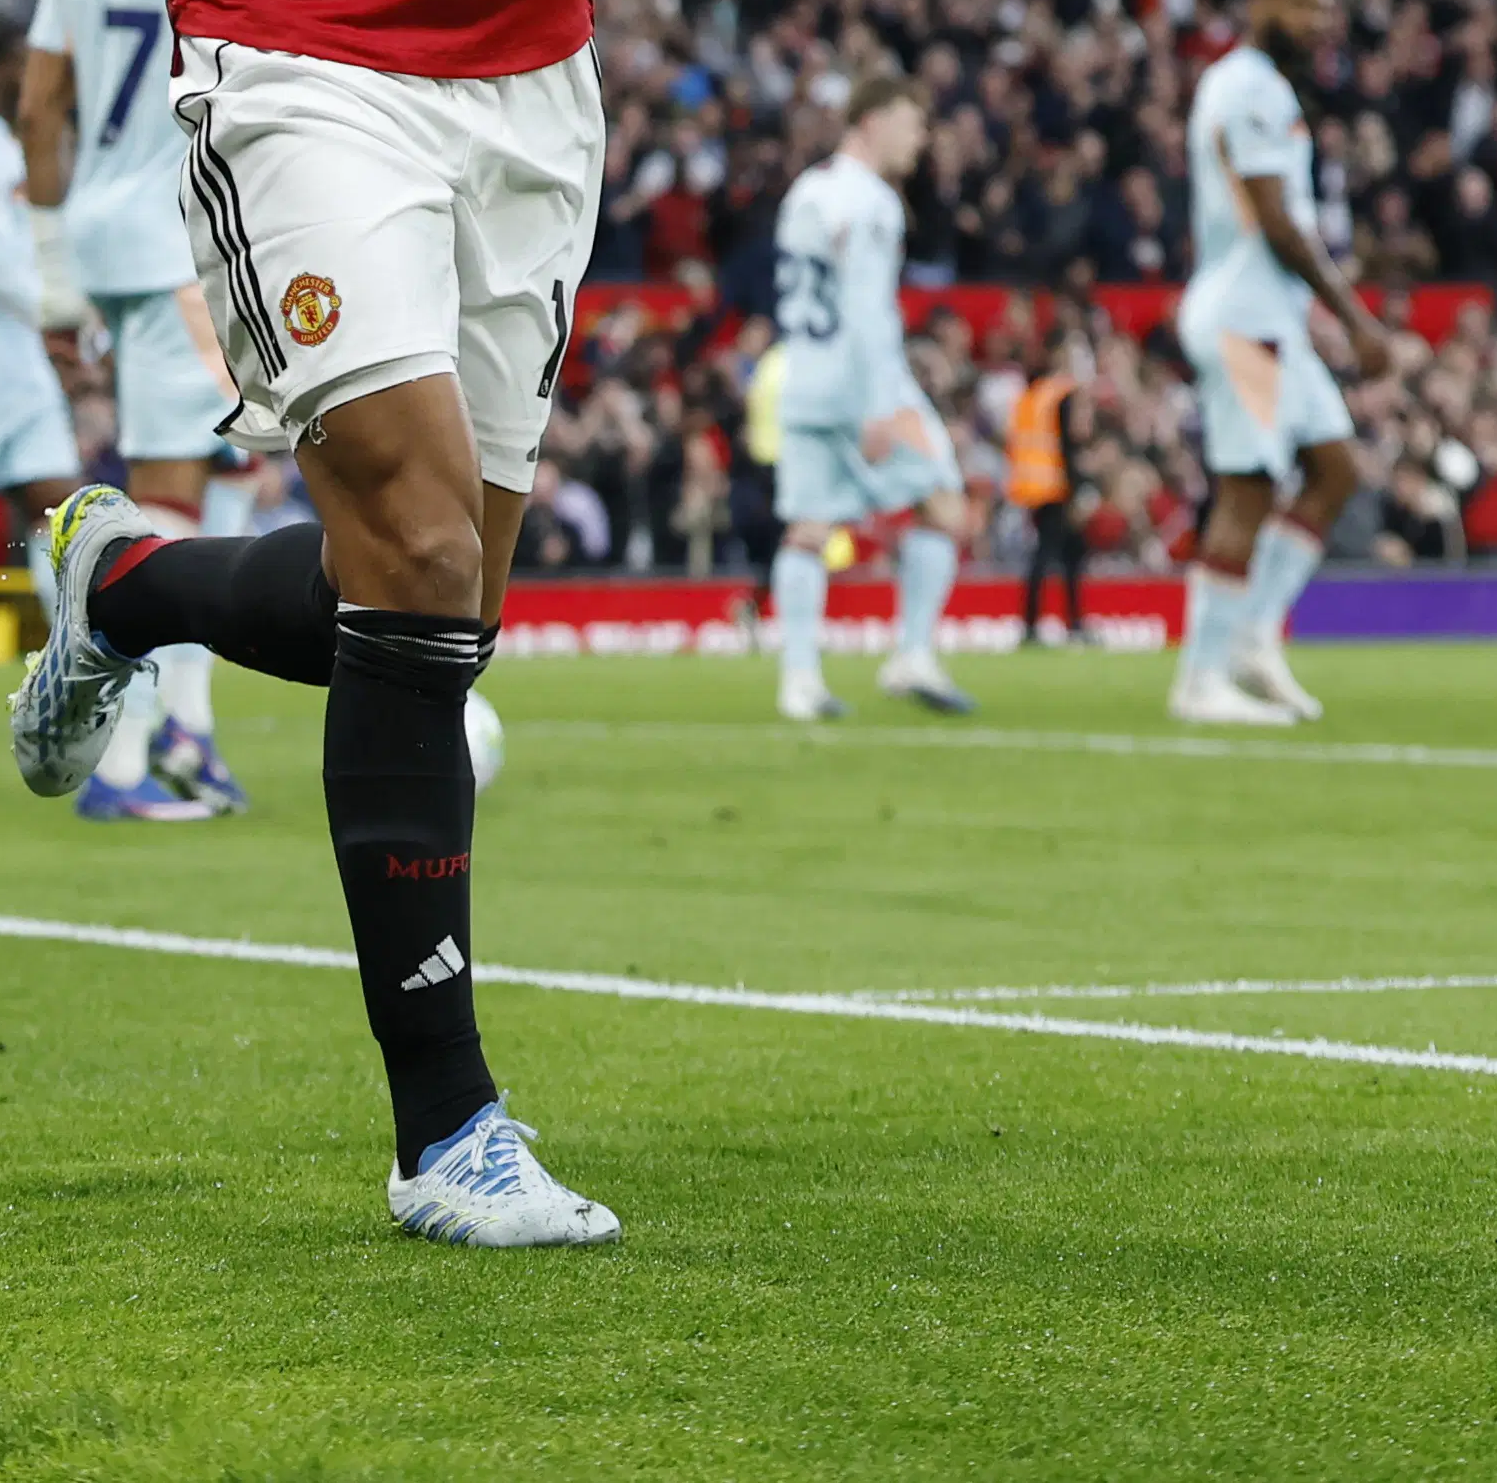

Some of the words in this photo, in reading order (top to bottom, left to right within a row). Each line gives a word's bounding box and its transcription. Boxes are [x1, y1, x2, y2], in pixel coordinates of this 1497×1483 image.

[98, 8, 162, 150] 7
[285, 277, 332, 313] MANCHESTER
[301, 320, 334, 343] UNITED
